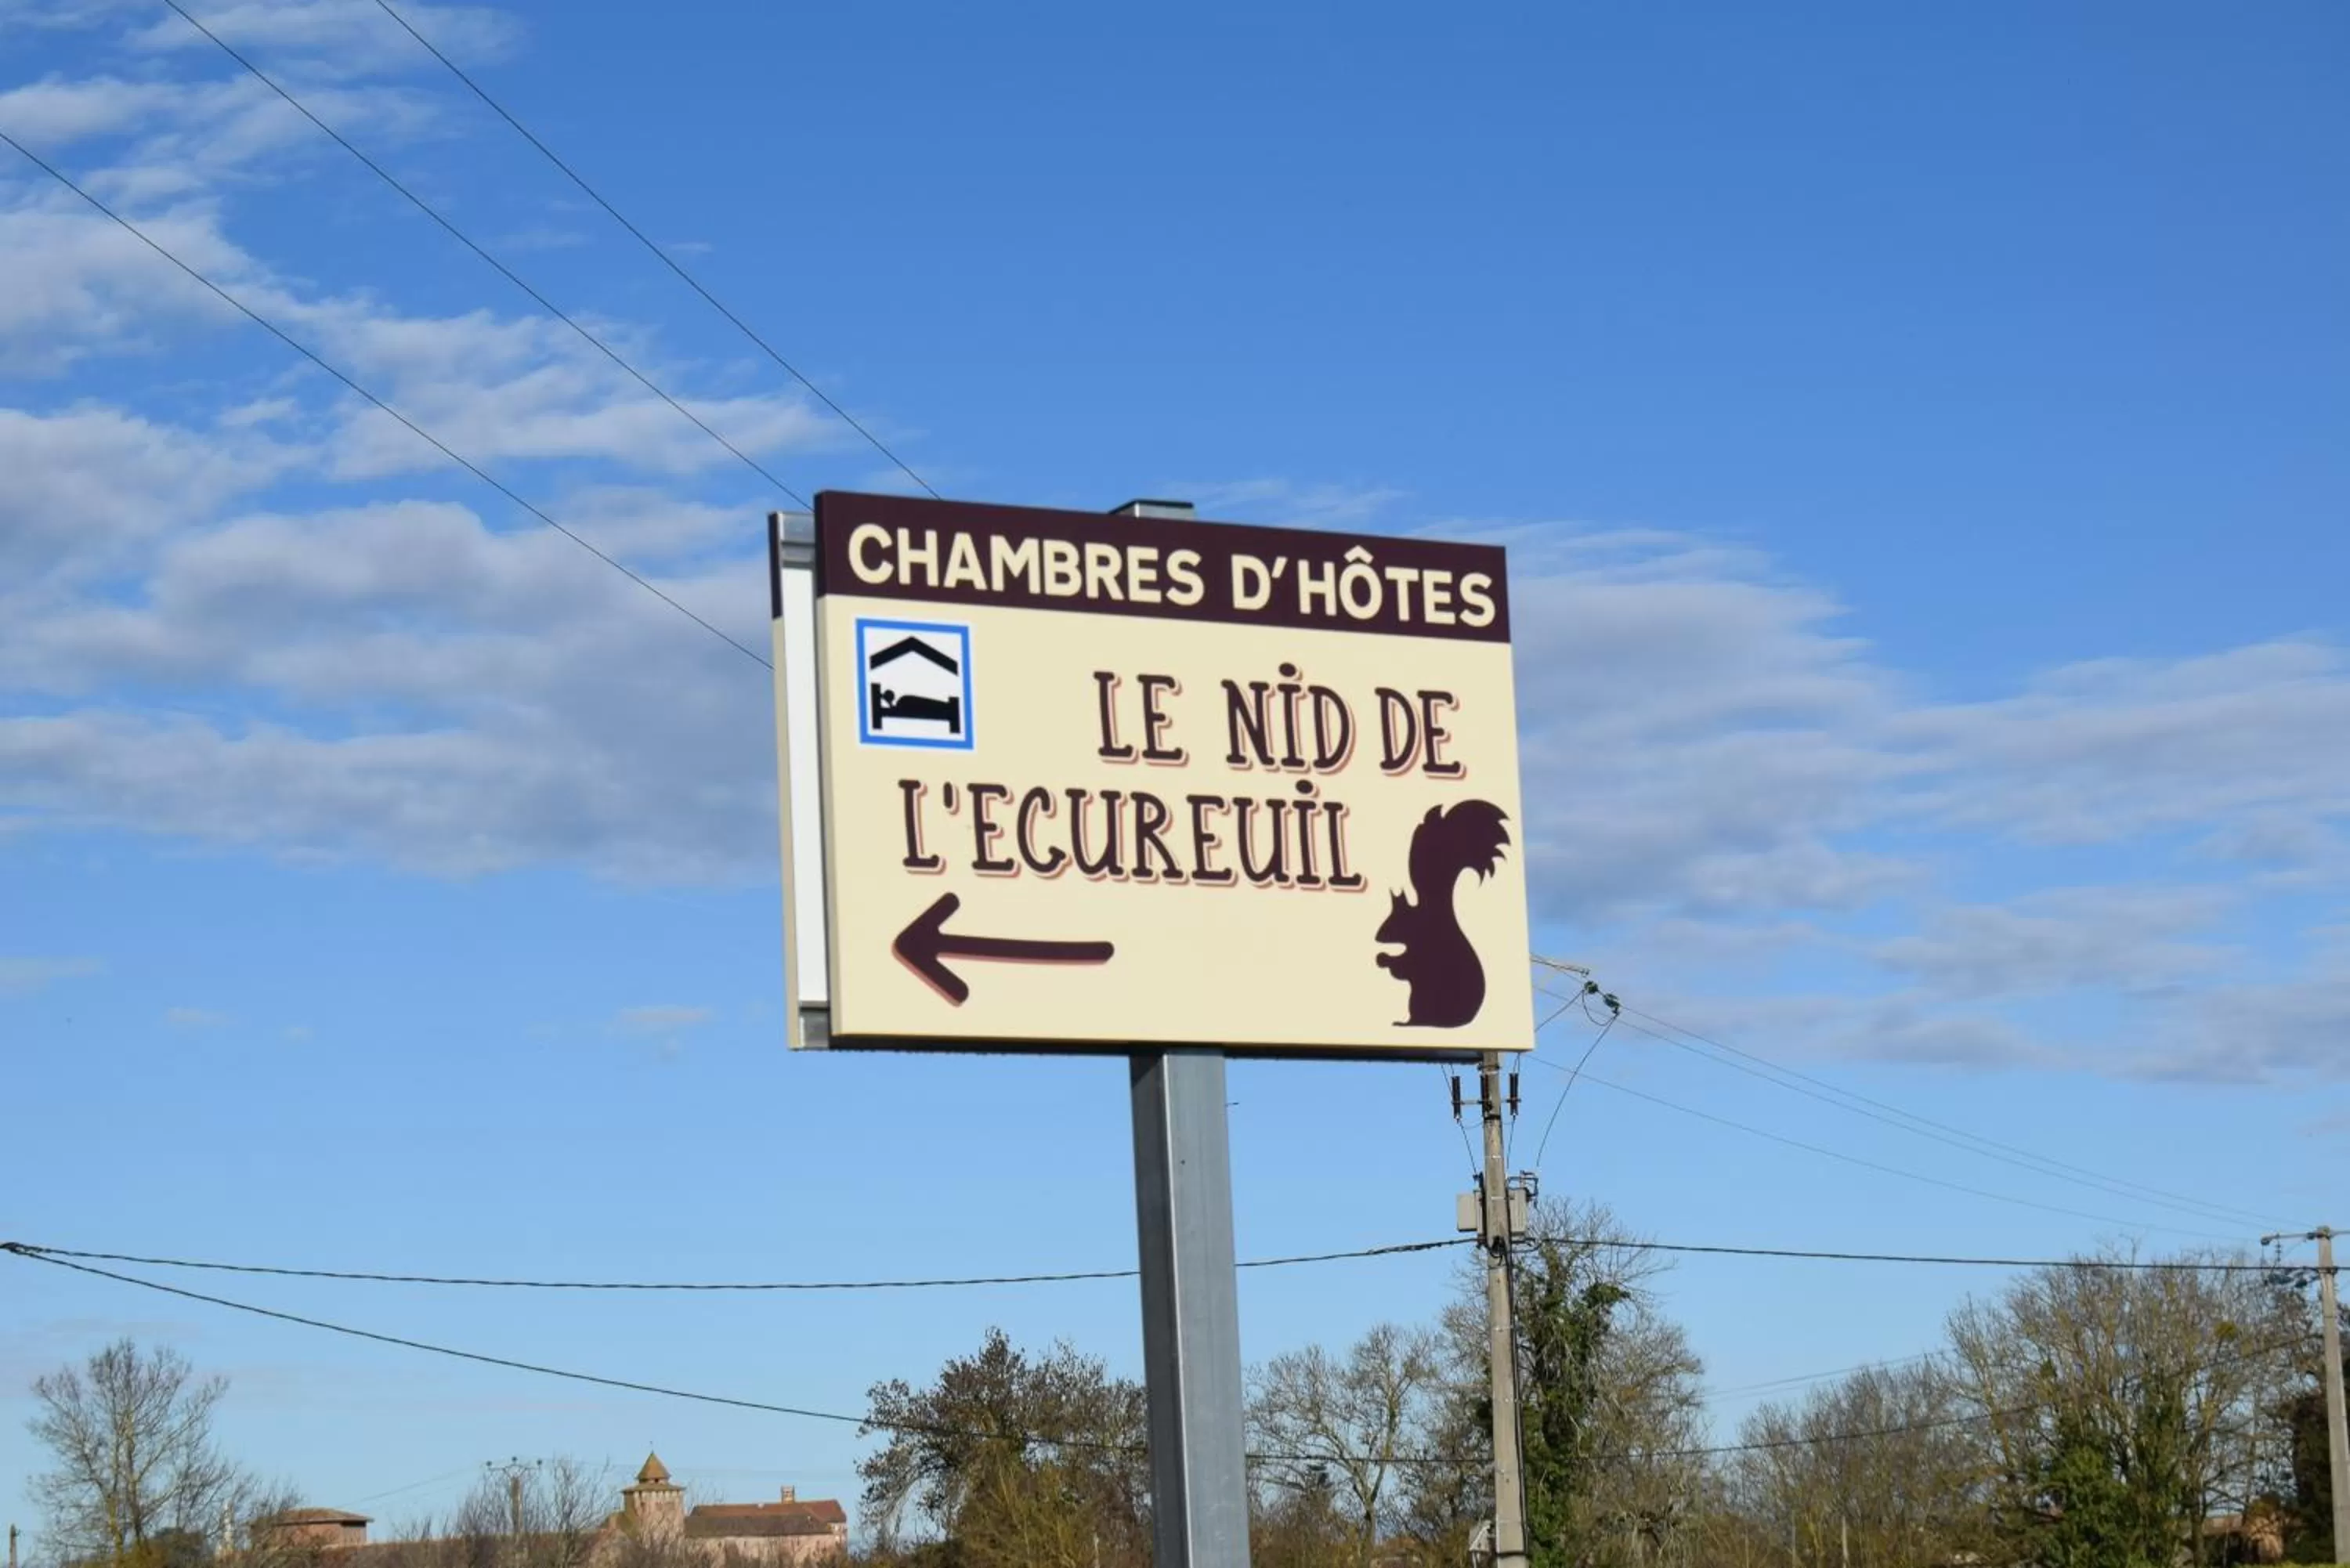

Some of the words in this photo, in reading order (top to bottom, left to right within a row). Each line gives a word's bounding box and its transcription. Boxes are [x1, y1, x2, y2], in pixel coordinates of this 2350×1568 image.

[847, 522, 1205, 606] CHAMBRES
[1092, 670, 1188, 766] LE
[1374, 686, 1466, 779] DE
